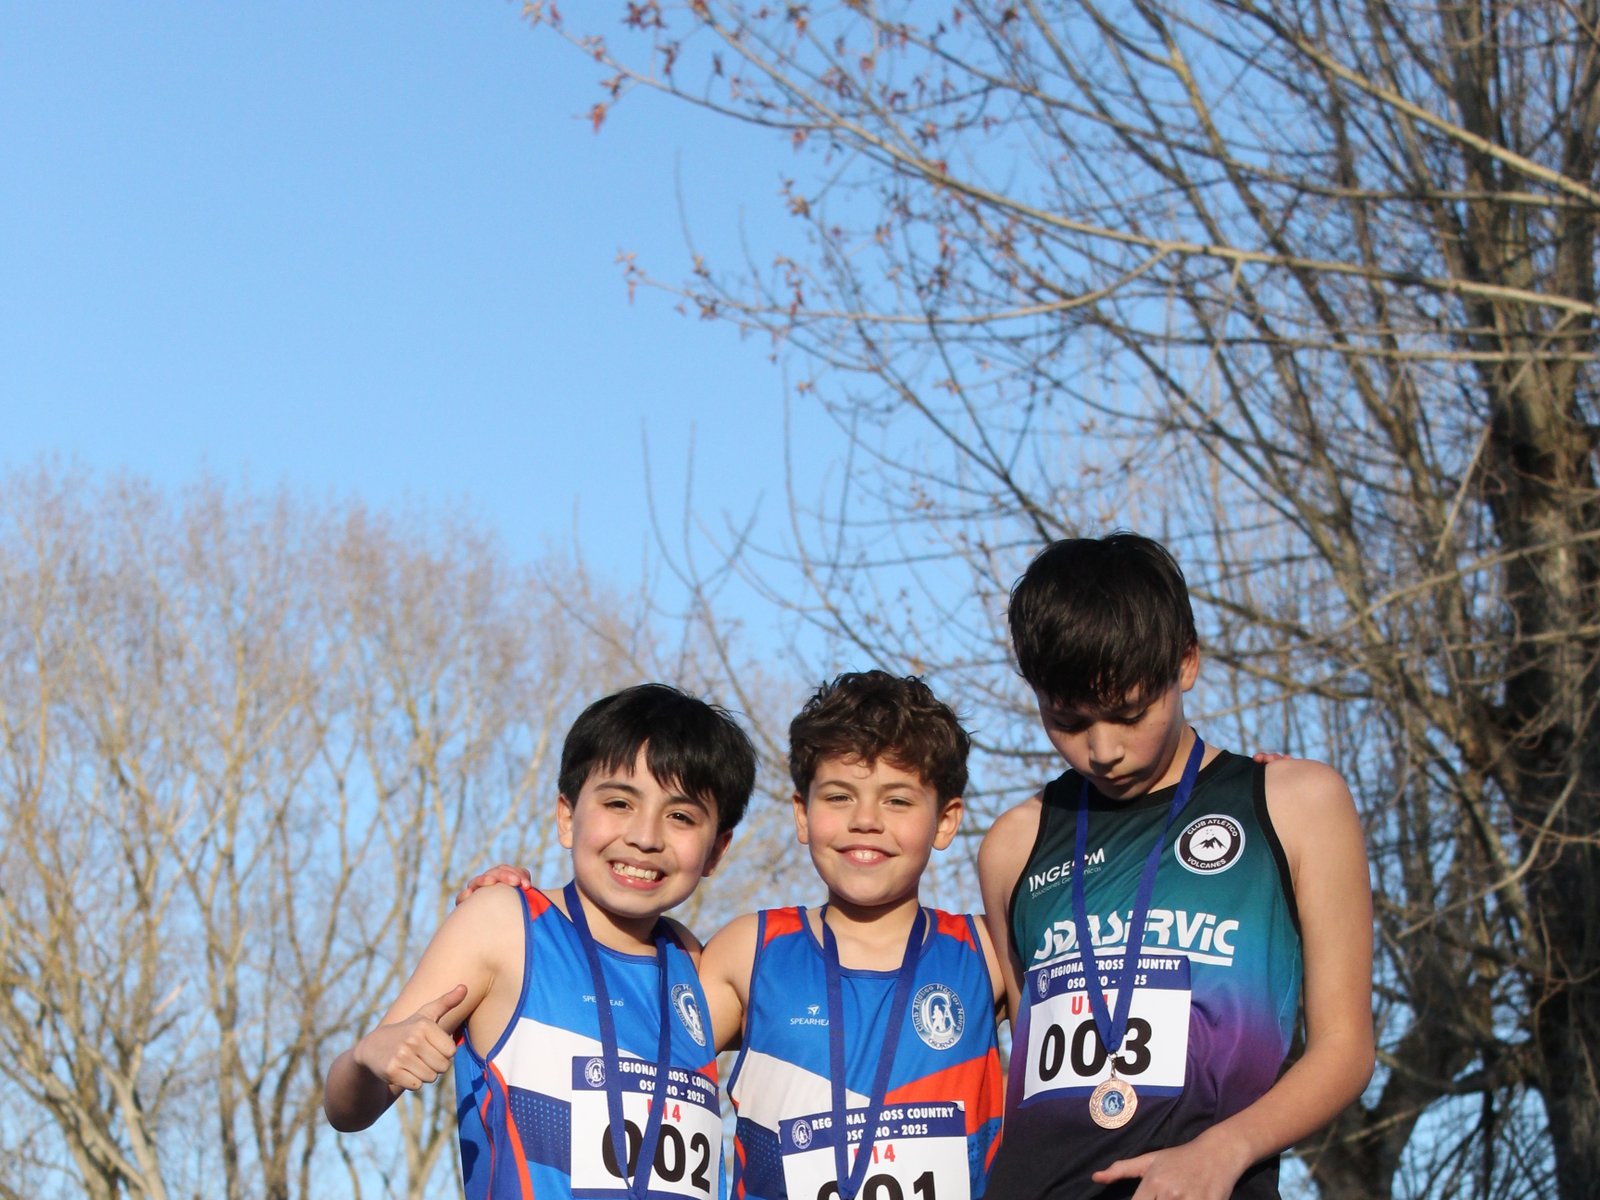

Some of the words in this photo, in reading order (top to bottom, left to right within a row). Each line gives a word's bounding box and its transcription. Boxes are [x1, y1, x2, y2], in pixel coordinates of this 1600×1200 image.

[1187, 819, 1206, 835] CLUB
[1028, 848, 1105, 892] INGEM
[1187, 856, 1227, 869] VOLCANES
[1051, 961, 1084, 979] REGIONA
[1096, 959, 1125, 971] ROSS
[1137, 958, 1181, 971] UNTRY
[1067, 975, 1108, 990] OSOO
[582, 995, 624, 1007] SPEEAD
[790, 1017, 829, 1026] SPEARHEA
[1038, 1017, 1152, 1082] 003
[618, 1061, 657, 1078] EGIONA
[668, 1070, 689, 1084] ROSS
[639, 1079, 678, 1097] OSNO
[686, 1088, 705, 1105] 2025
[811, 1113, 866, 1131] REGNAL
[879, 1108, 904, 1121] OSS
[907, 1106, 954, 1119] COUNTRY
[847, 1126, 890, 1142] SONO
[901, 1124, 928, 1136] 2025
[602, 1119, 711, 1194] 002
[853, 1143, 896, 1164] 14
